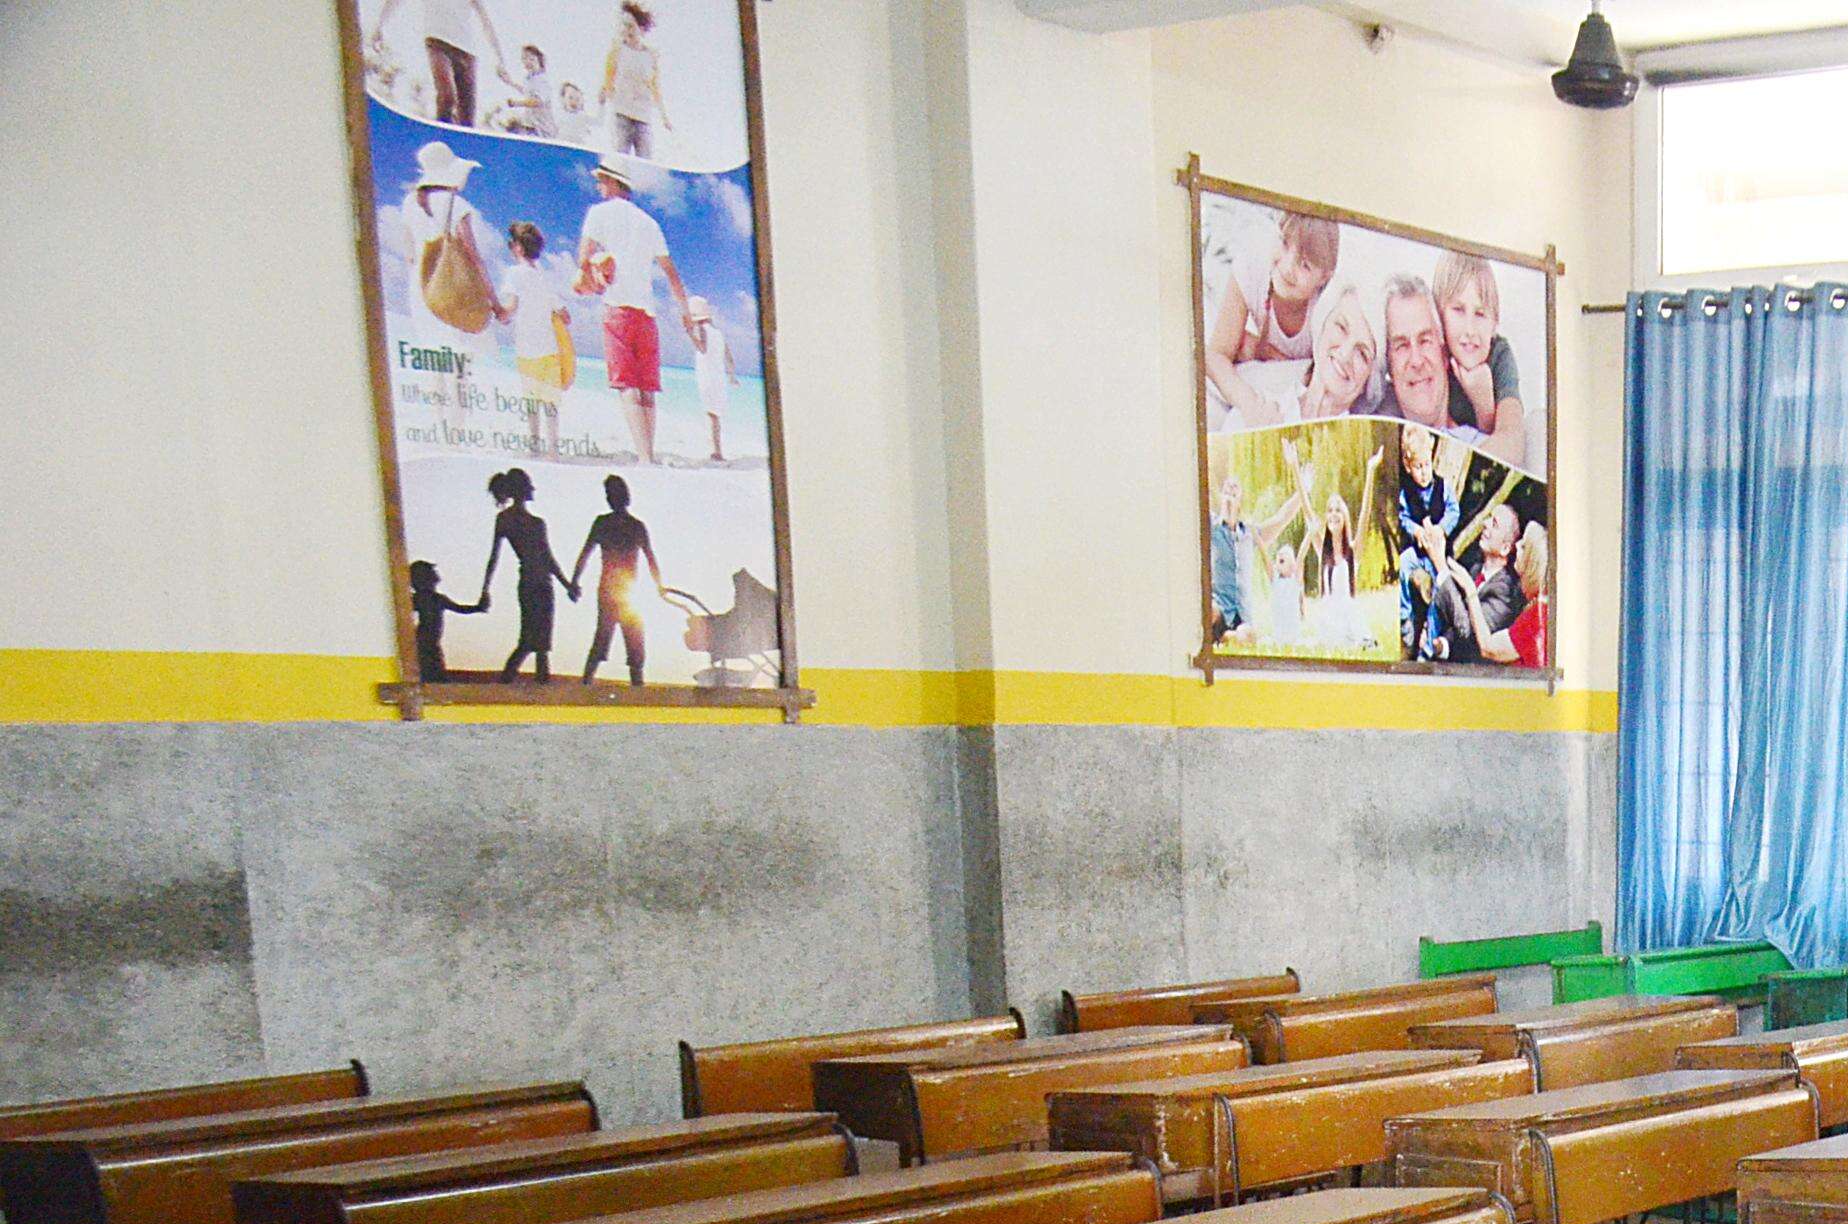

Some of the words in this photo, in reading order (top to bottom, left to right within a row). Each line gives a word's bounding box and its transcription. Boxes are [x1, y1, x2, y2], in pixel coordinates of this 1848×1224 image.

[398, 340, 473, 379] Family:
[457, 382, 489, 412] life
[494, 388, 558, 422] begins
[405, 424, 438, 445] and
[441, 419, 485, 448] love
[492, 431, 546, 452] never
